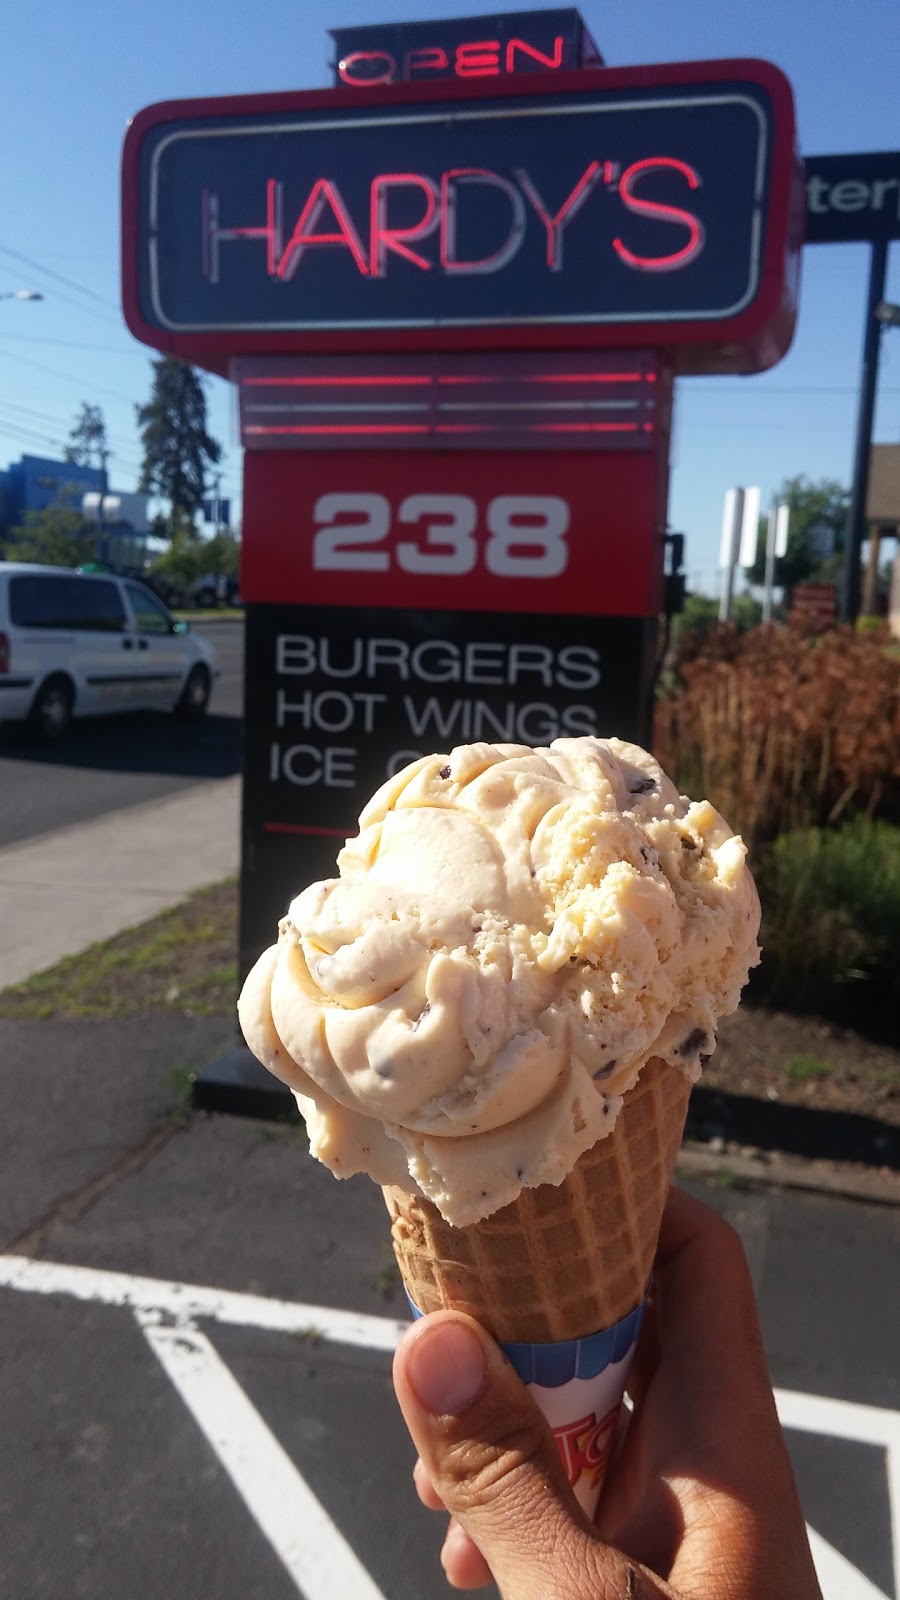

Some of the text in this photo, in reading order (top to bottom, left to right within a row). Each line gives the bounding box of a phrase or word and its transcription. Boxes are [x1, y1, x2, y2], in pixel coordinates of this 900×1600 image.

[338, 35, 564, 87] OPEN
[203, 156, 705, 283] HARDY'S
[806, 175, 900, 221] ter
[312, 491, 571, 578] 238
[275, 634, 600, 690] BURGERS
[276, 689, 598, 744] HOT WINGS
[269, 743, 357, 788] ICE
